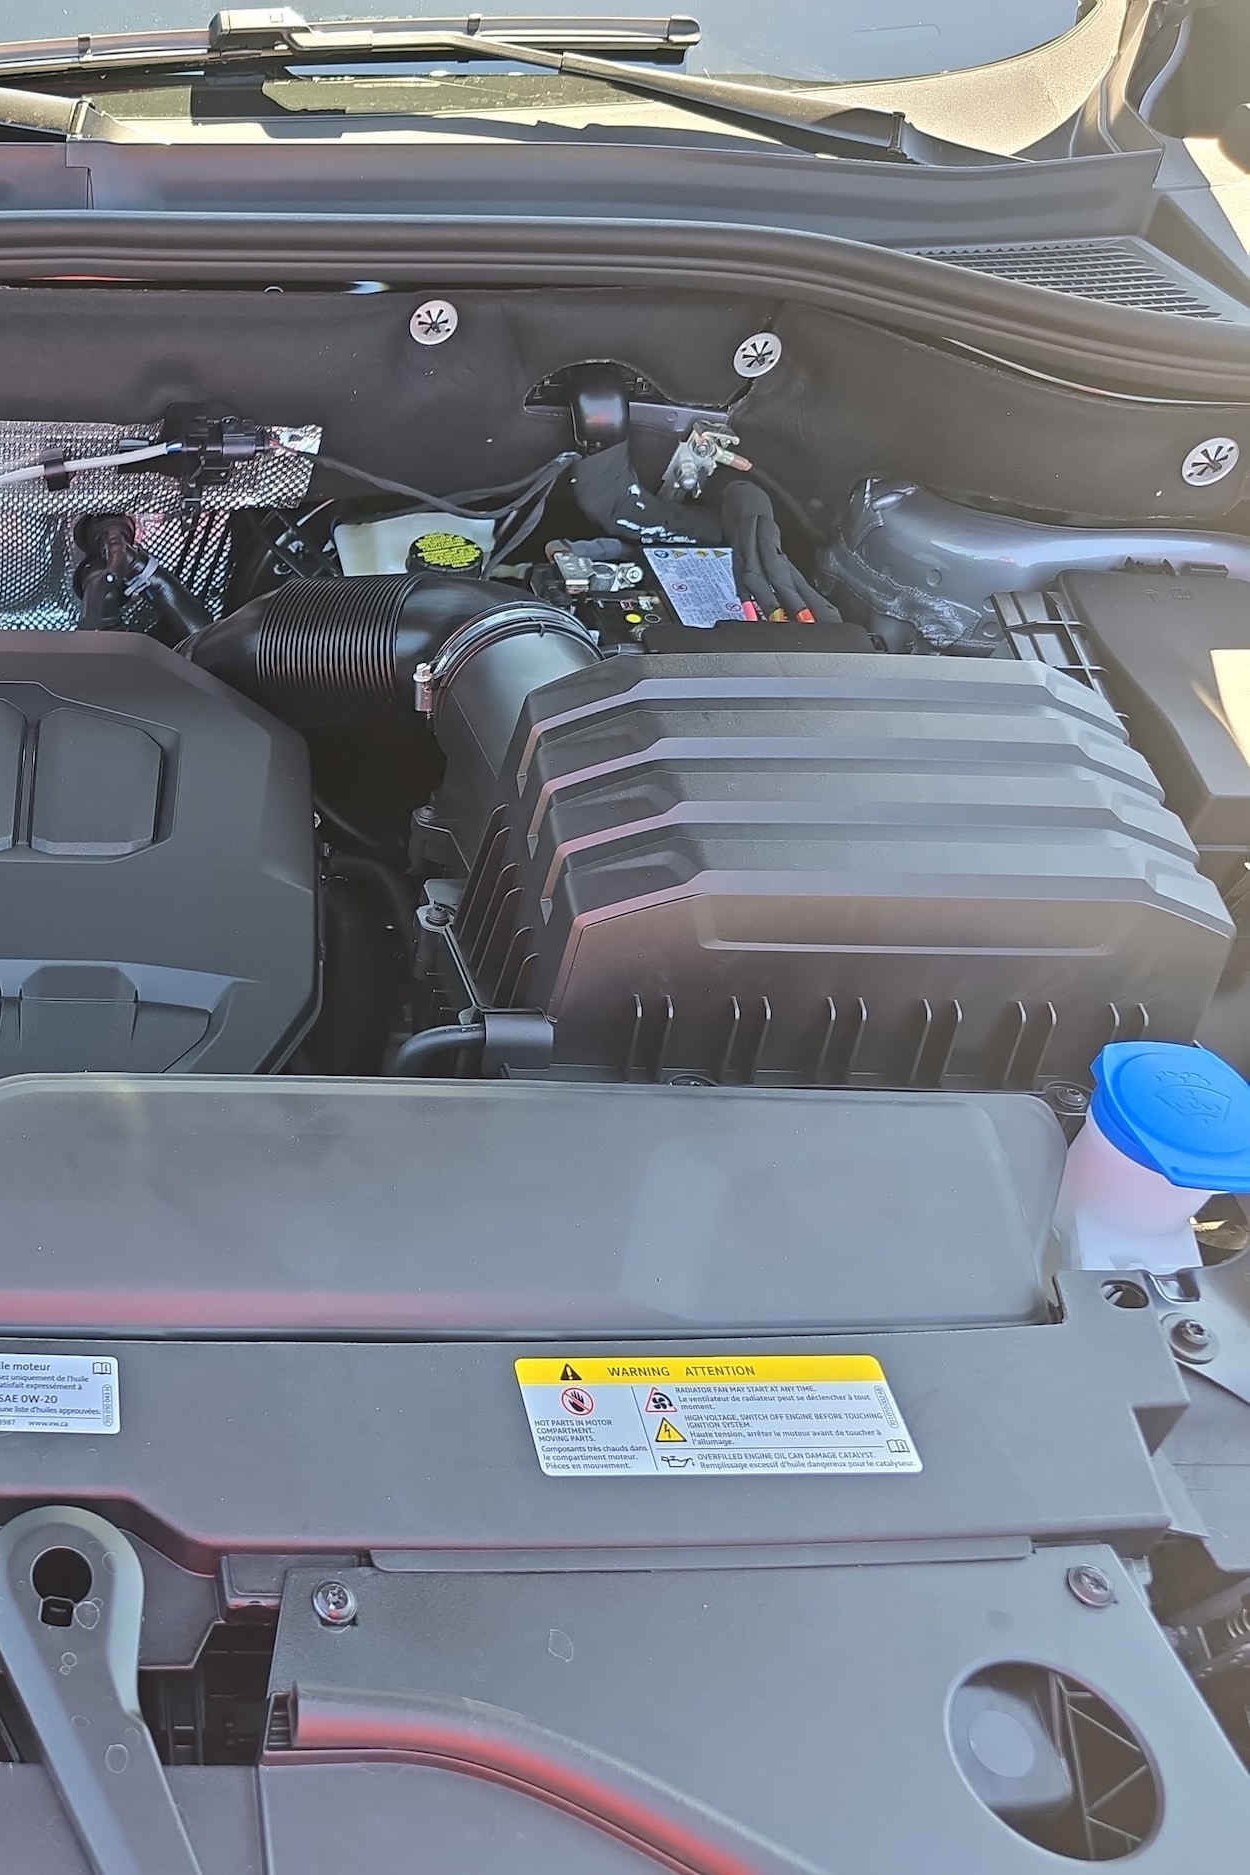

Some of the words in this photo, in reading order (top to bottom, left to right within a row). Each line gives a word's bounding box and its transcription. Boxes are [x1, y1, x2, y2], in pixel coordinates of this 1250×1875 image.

[13, 1363, 51, 1371] moteur
[607, 1366, 670, 1377] WARNING
[685, 1366, 755, 1376] ATTENTION
[21, 1394, 57, 1404] 0W-20
[552, 1454, 606, 1462] compartiment
[700, 1462, 748, 1470] Remplissage
